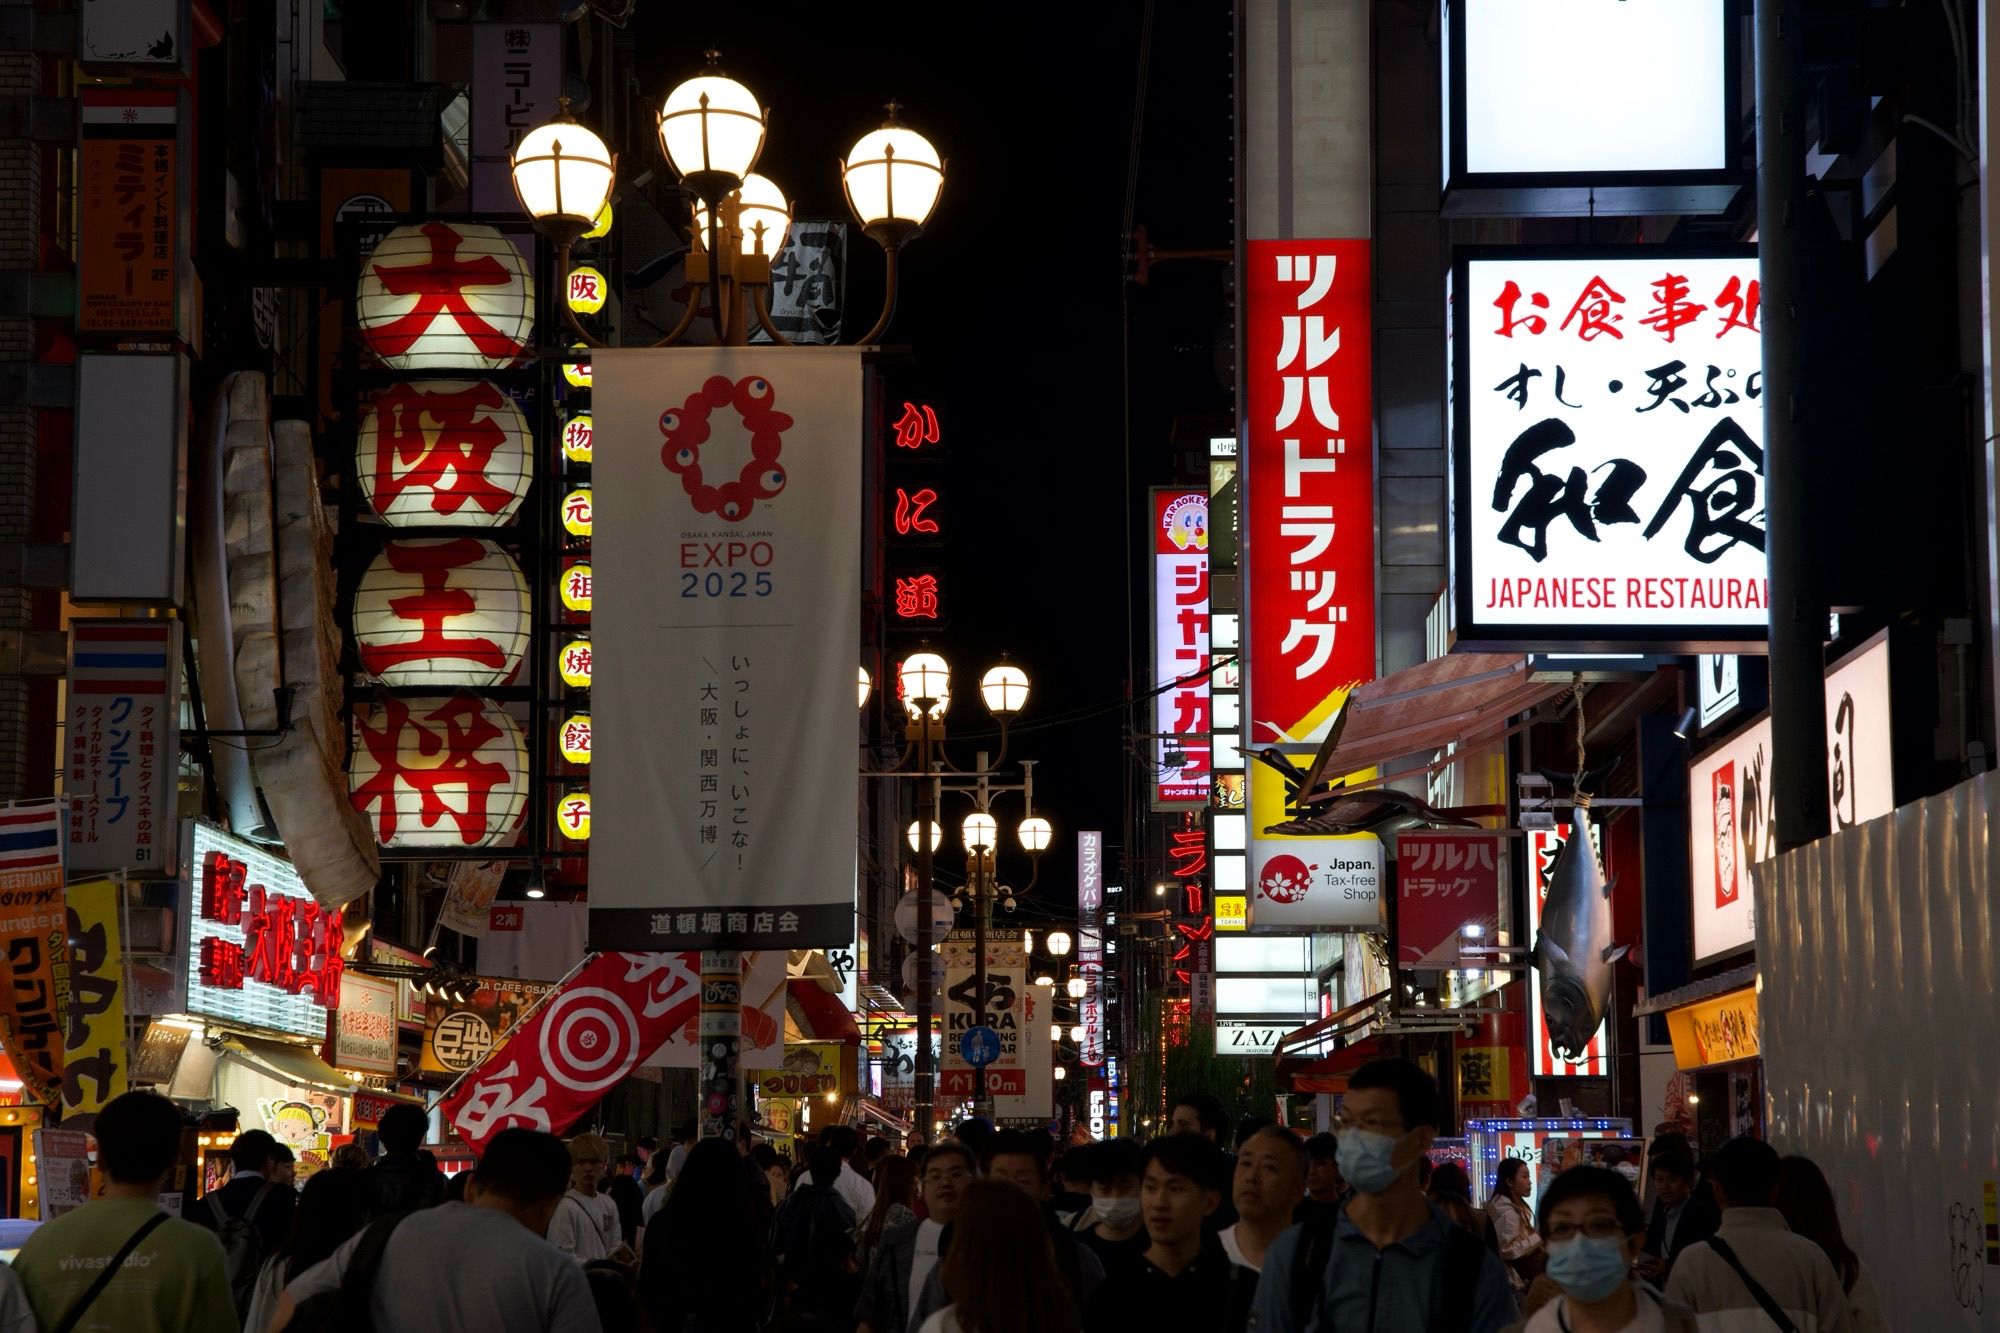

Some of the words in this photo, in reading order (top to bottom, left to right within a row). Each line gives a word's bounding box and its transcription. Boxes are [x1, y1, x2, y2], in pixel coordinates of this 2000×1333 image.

[153, 143, 169, 259] 本格インド料理店
[113, 143, 146, 295] ミティラー
[1491, 272, 1760, 343] お食事処
[1275, 255, 1347, 680] ツルハドラッグ
[1491, 416, 1766, 564] 和食
[746, 530, 773, 538] JAPAN
[680, 541, 774, 569] EXPO
[894, 402, 940, 702] かに道
[681, 571, 773, 598] 2025
[1487, 577, 1617, 609] JAPANESE
[87, 705, 104, 843] タイカルチャースクール
[105, 696, 134, 824] クンテープ
[136, 705, 155, 845] タイ料理とタイスキの店
[135, 848, 151, 862] B1
[1329, 858, 1376, 872] Japan.
[1402, 843, 1495, 872] ツルハ
[1324, 873, 1377, 887] Tax-free
[1403, 877, 1478, 898] ドラッグ
[1343, 887, 1377, 902] Shop
[650, 911, 800, 934] 道頓堀商店会
[494, 983, 521, 993] CAFE
[949, 1012, 1017, 1030] KURA
[1462, 1054, 1491, 1095] 薬
[59, 1253, 152, 1272] vivastdio
